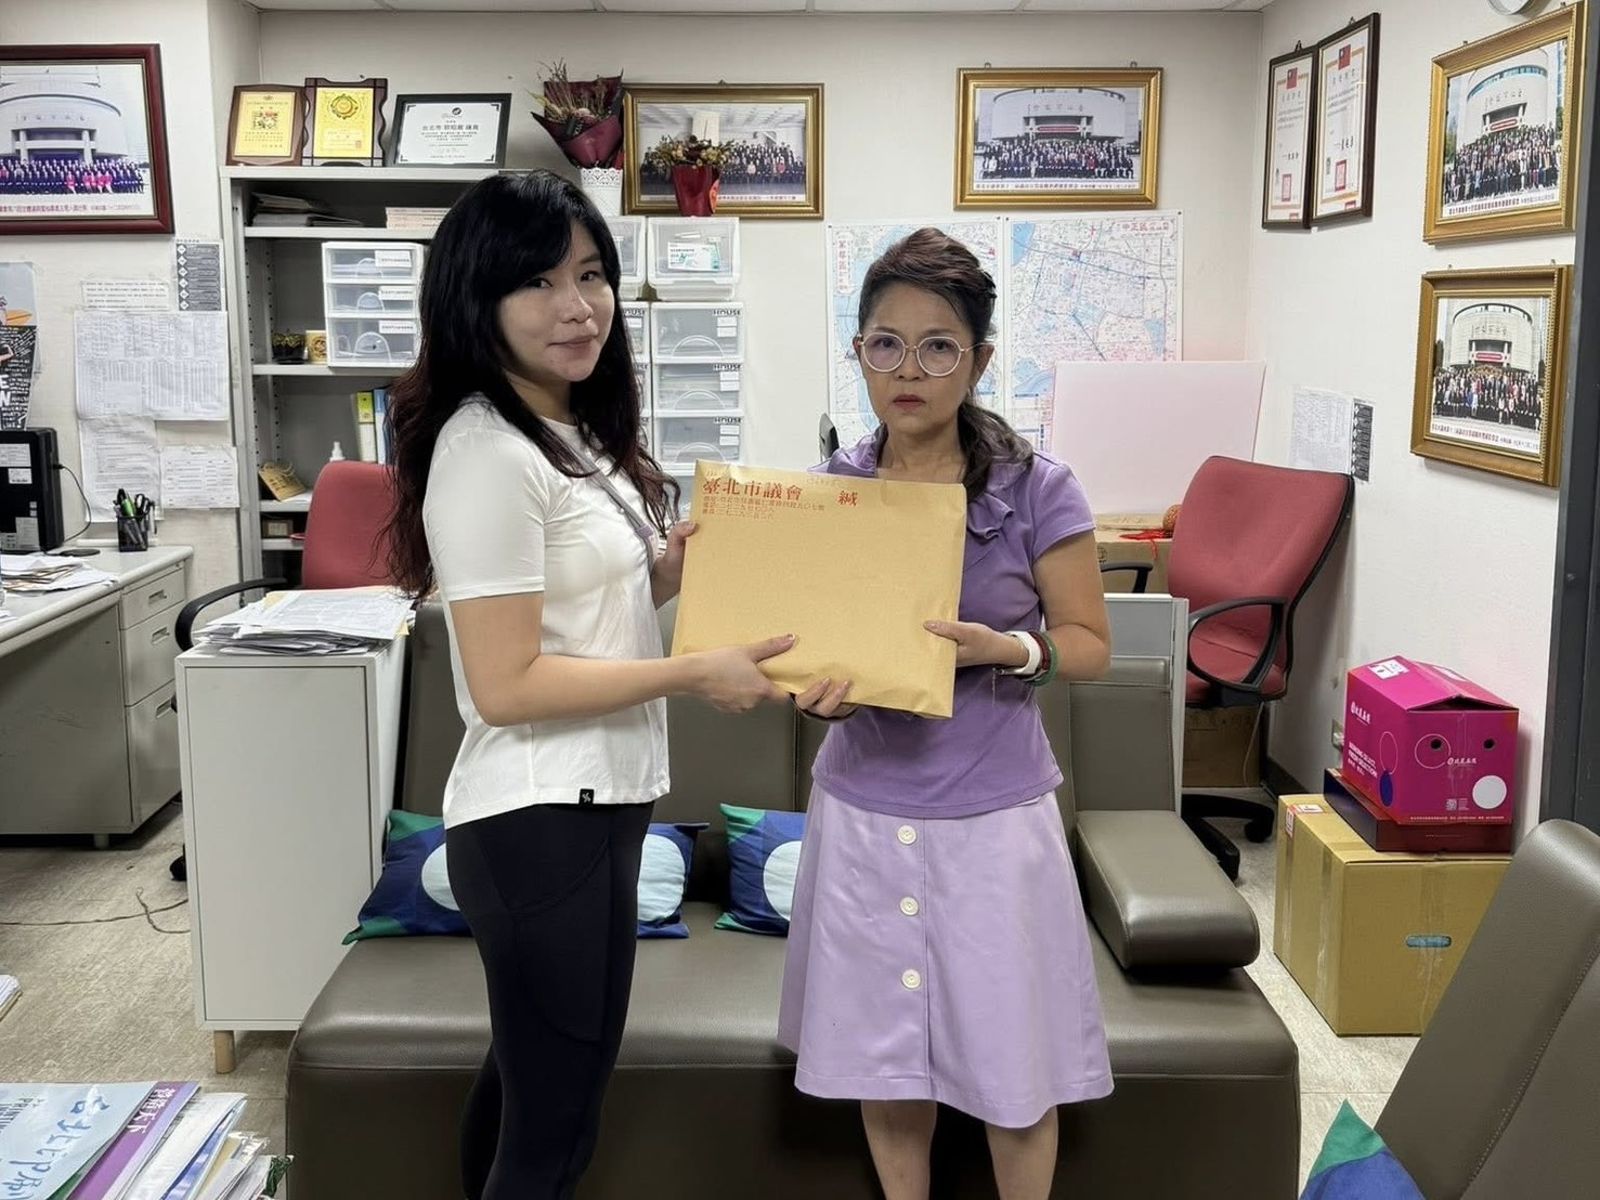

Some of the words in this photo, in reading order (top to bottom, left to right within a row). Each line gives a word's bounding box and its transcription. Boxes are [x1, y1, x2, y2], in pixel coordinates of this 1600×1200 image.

[703, 477, 803, 501] 臺北市議會
[837, 490, 859, 507] 緘
